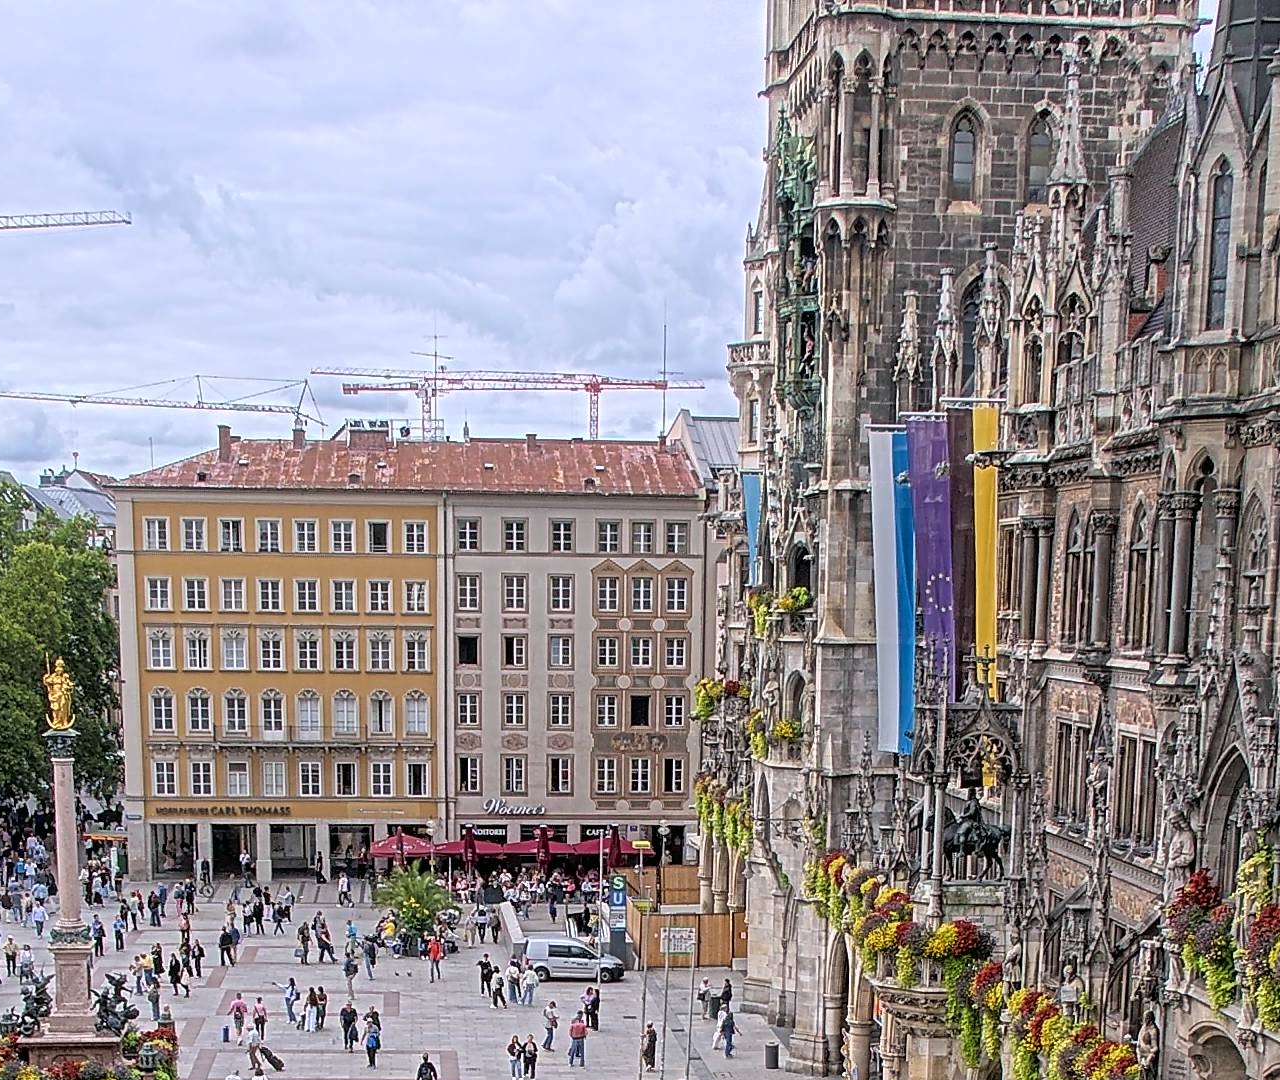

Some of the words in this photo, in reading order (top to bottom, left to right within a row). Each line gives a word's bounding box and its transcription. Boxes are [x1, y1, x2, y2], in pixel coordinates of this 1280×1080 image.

[210, 806, 237, 817] CARL
[238, 806, 291, 817] THOMASS
[613, 877, 624, 890] S
[613, 893, 623, 905] U
